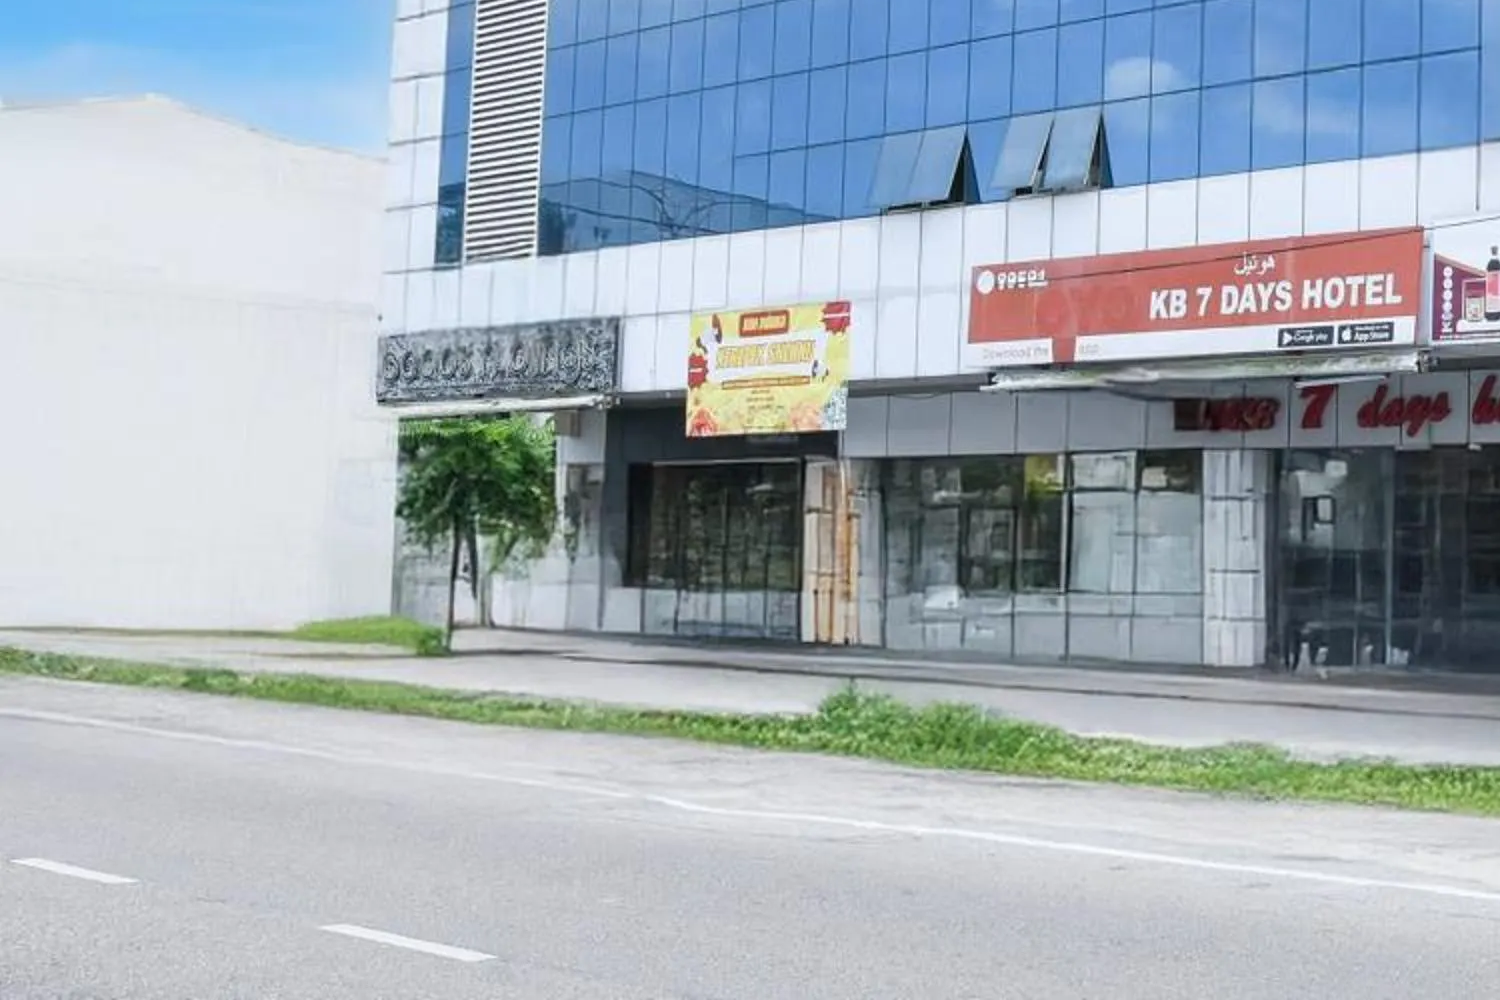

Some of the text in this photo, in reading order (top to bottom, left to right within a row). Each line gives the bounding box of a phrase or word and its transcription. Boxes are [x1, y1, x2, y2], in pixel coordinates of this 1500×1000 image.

[1149, 288, 1187, 320] KB
[1197, 286, 1213, 316] 7
[1219, 279, 1293, 315] DAYS
[1301, 273, 1402, 310] HOTEL
[1300, 384, 1338, 429] 7
[1357, 384, 1451, 437] days
